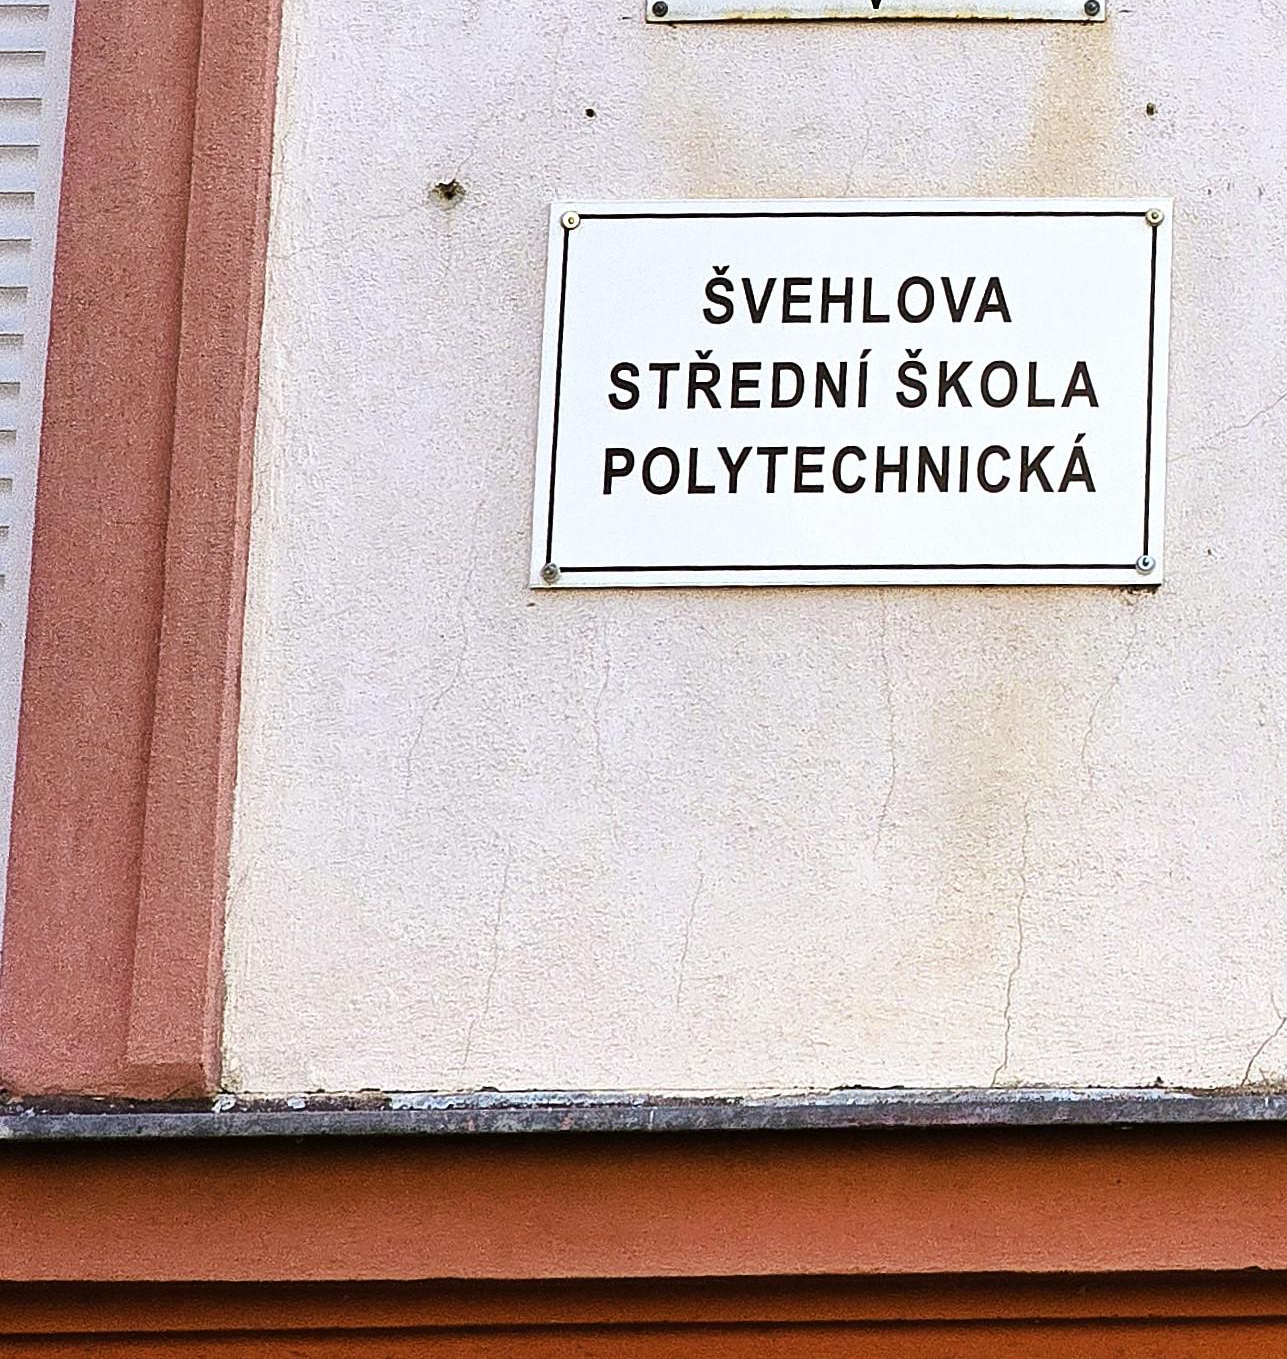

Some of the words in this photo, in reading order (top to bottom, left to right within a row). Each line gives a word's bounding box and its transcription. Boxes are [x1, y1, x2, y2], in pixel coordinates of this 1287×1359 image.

[701, 264, 1013, 325] ŠVEHLOVA
[607, 348, 871, 411] STŘEDNÍ
[895, 348, 1100, 410] ŠKOLA
[601, 432, 1097, 496] POLYTECHNICKÁ
